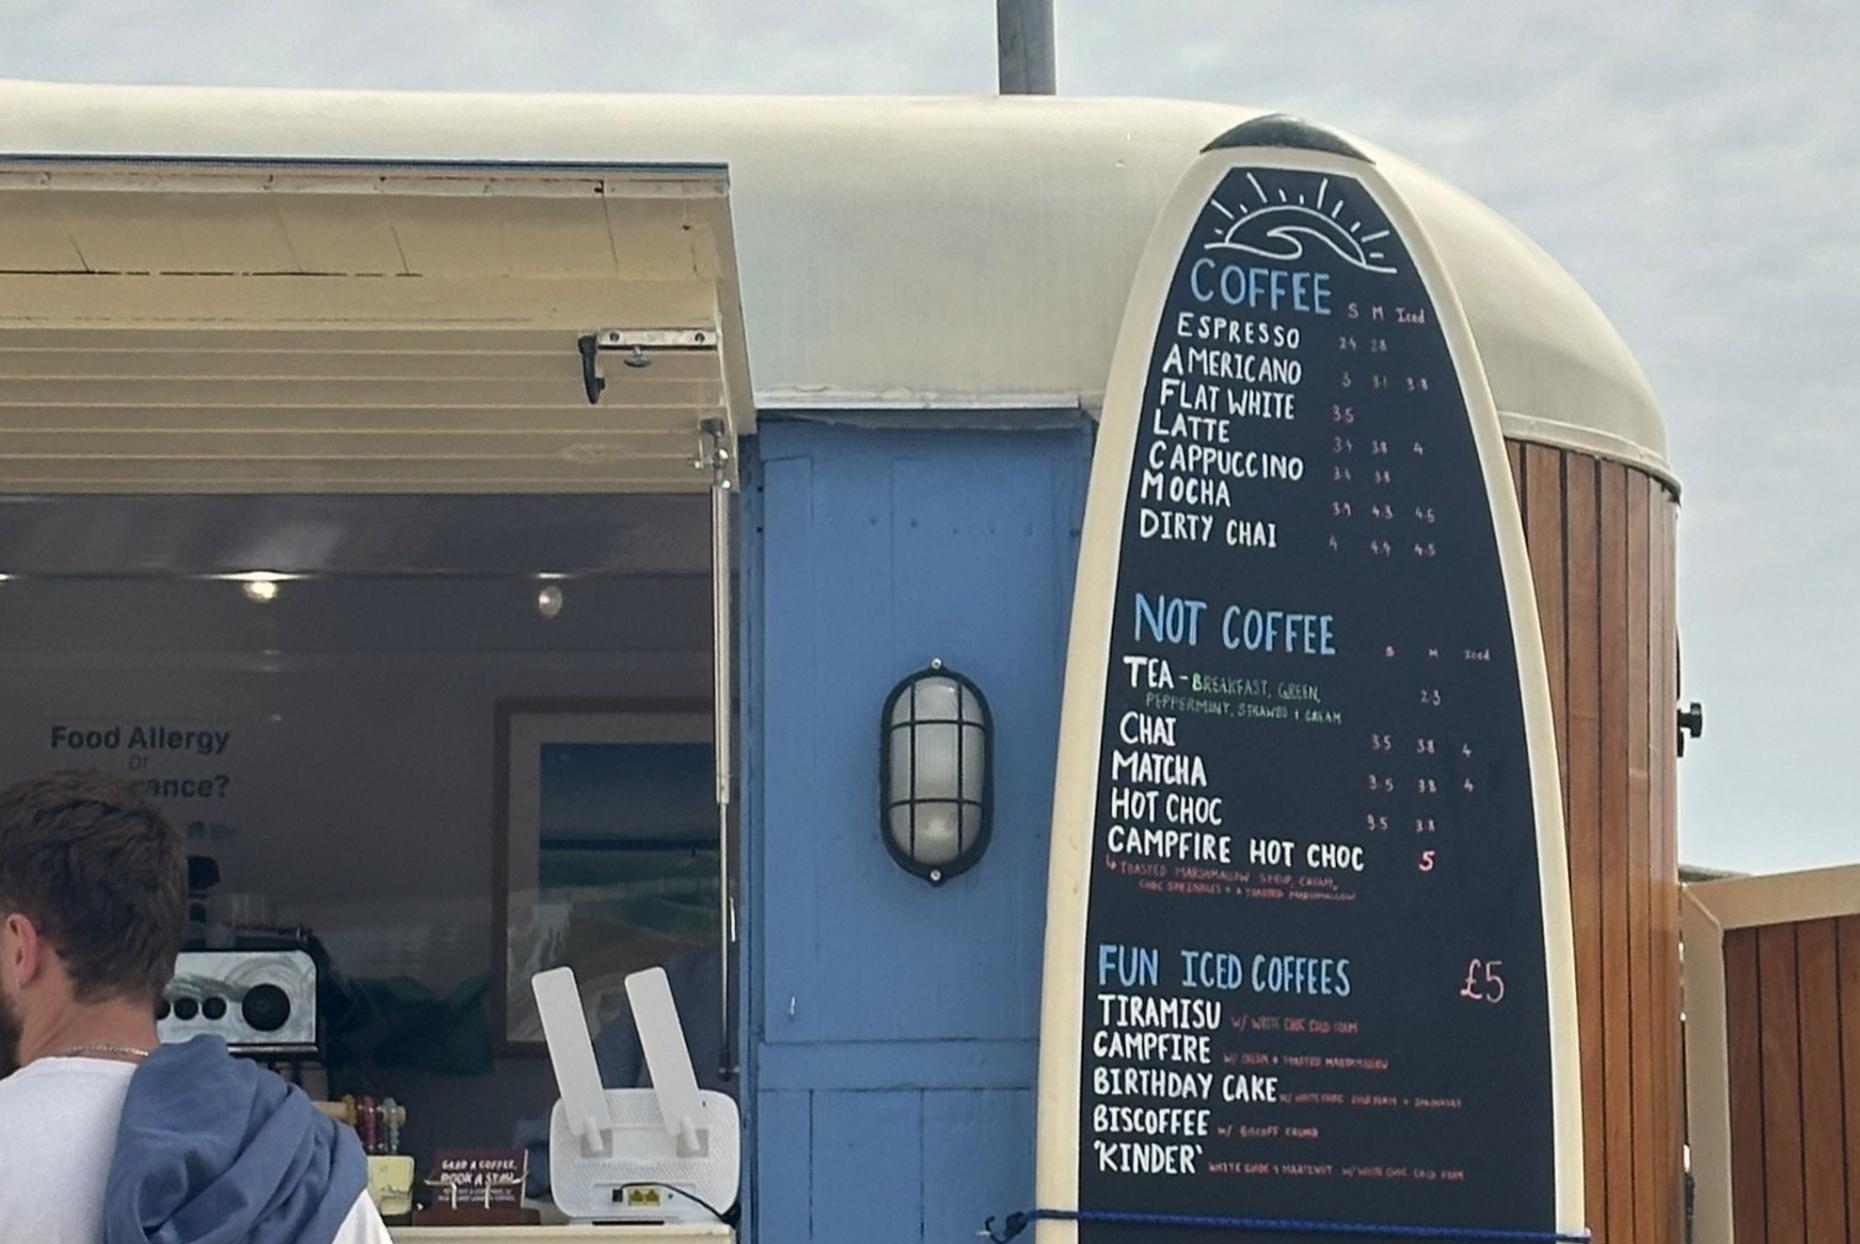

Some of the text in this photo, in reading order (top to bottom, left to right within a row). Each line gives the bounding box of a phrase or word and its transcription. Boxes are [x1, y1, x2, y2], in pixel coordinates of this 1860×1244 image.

[1191, 258, 1330, 314] COFFEE
[1348, 302, 1359, 319] S
[1372, 305, 1384, 320] M
[1178, 312, 1299, 348] ESPRESSO
[1162, 342, 1301, 387] AMERICANO
[1161, 378, 1220, 412] FLAT
[1228, 389, 1294, 419] WHITE
[1154, 409, 1229, 443] LATTE
[1149, 440, 1303, 480] CAPPUCCINO
[1141, 468, 1230, 507] MOCHA
[1140, 509, 1213, 541] DIRTY
[1227, 520, 1276, 547] CHAI
[1135, 593, 1335, 654] NOT COFFEE
[1123, 656, 1174, 688] TEA
[51, 726, 230, 755] Food Allergy
[1120, 711, 1176, 746] CHAI
[1112, 750, 1207, 786] MATCHA
[1112, 787, 1159, 822] HOT
[1166, 794, 1221, 825] CHOC
[1108, 825, 1435, 872] CAMPFIRE HOT CHOC 5
[1099, 945, 1504, 1002] FUN ICED COFFEES £5
[1098, 994, 1220, 1029] TIRAMISU
[1094, 1031, 1210, 1063] CAMPFIRE
[1094, 1067, 1277, 1102] BIRTHDAY CAKE
[1094, 1104, 1210, 1136] BISCOFFEE
